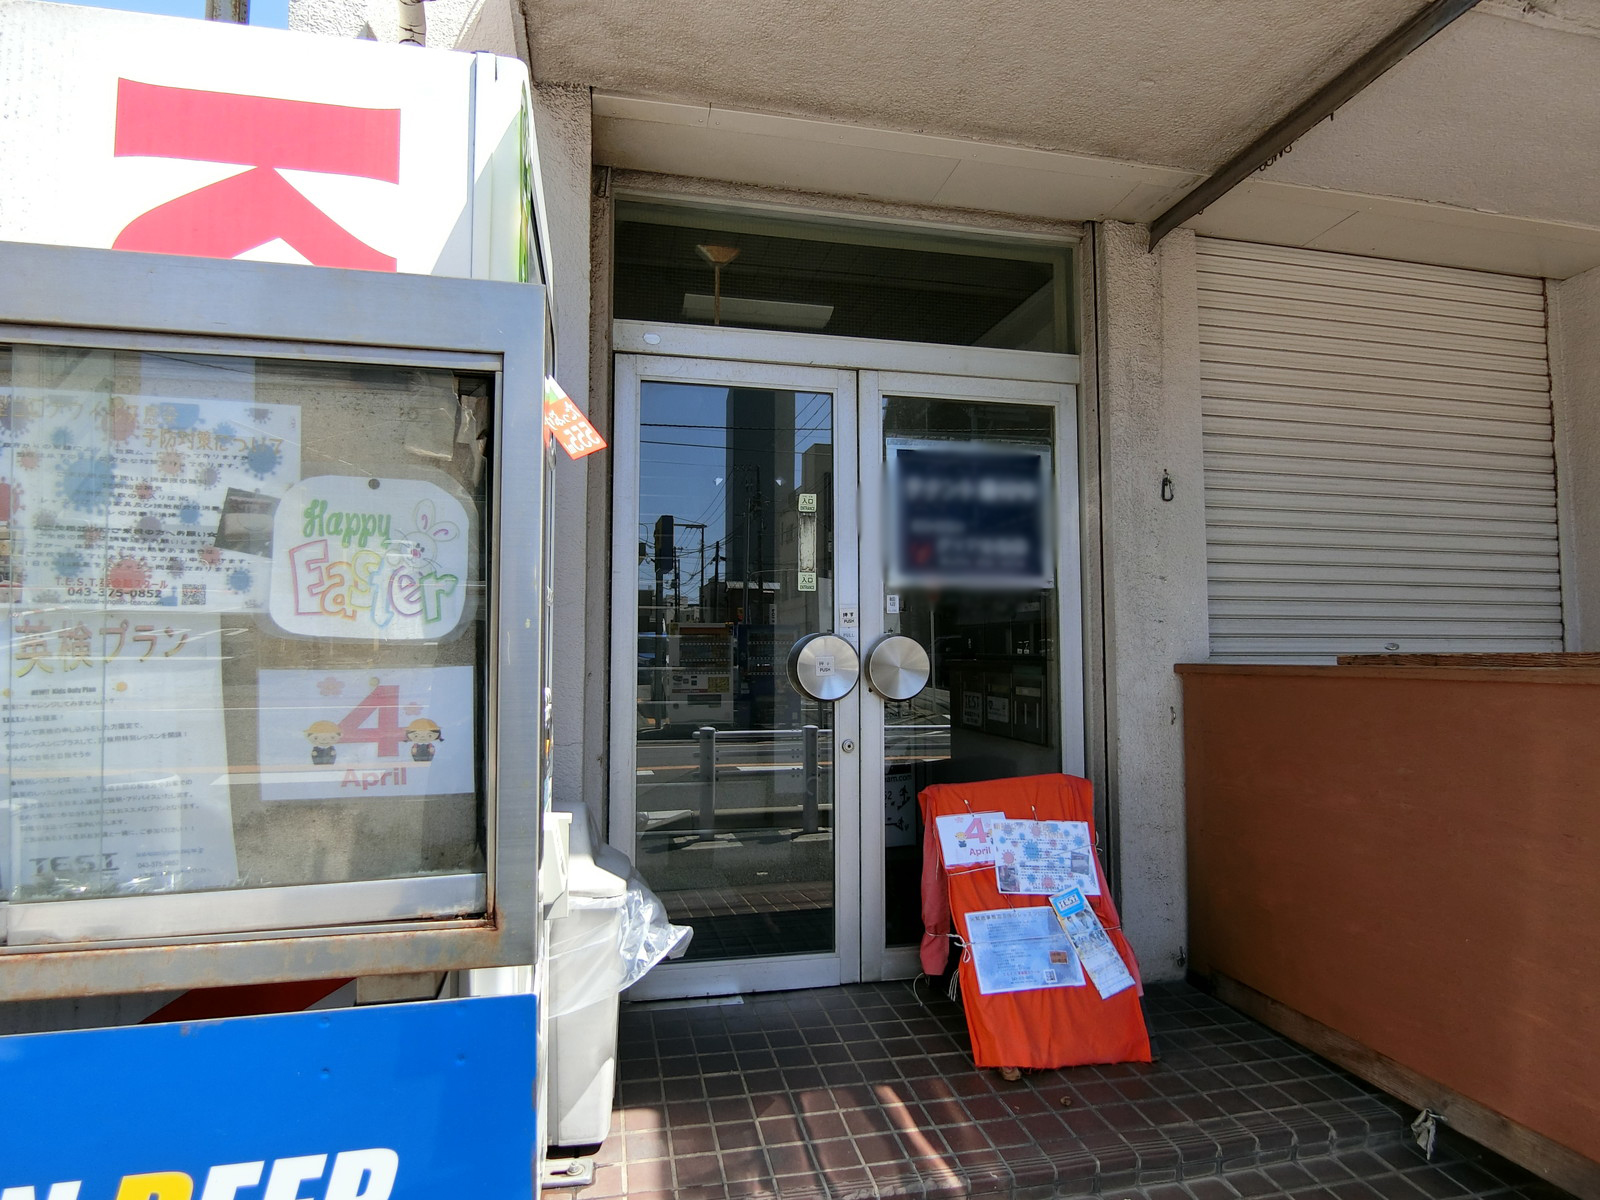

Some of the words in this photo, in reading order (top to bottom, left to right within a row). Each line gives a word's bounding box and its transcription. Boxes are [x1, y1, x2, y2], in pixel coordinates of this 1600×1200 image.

[802, 497, 814, 505] 入口
[303, 499, 392, 549] Happy
[67, 587, 162, 599] 043-375-0852
[289, 539, 459, 628] Easter
[14, 619, 189, 677] 英検プラン
[337, 684, 408, 758] 4
[341, 768, 407, 791] April
[965, 817, 988, 843] 4
[970, 847, 992, 856] April
[1058, 895, 1079, 913] TEST
